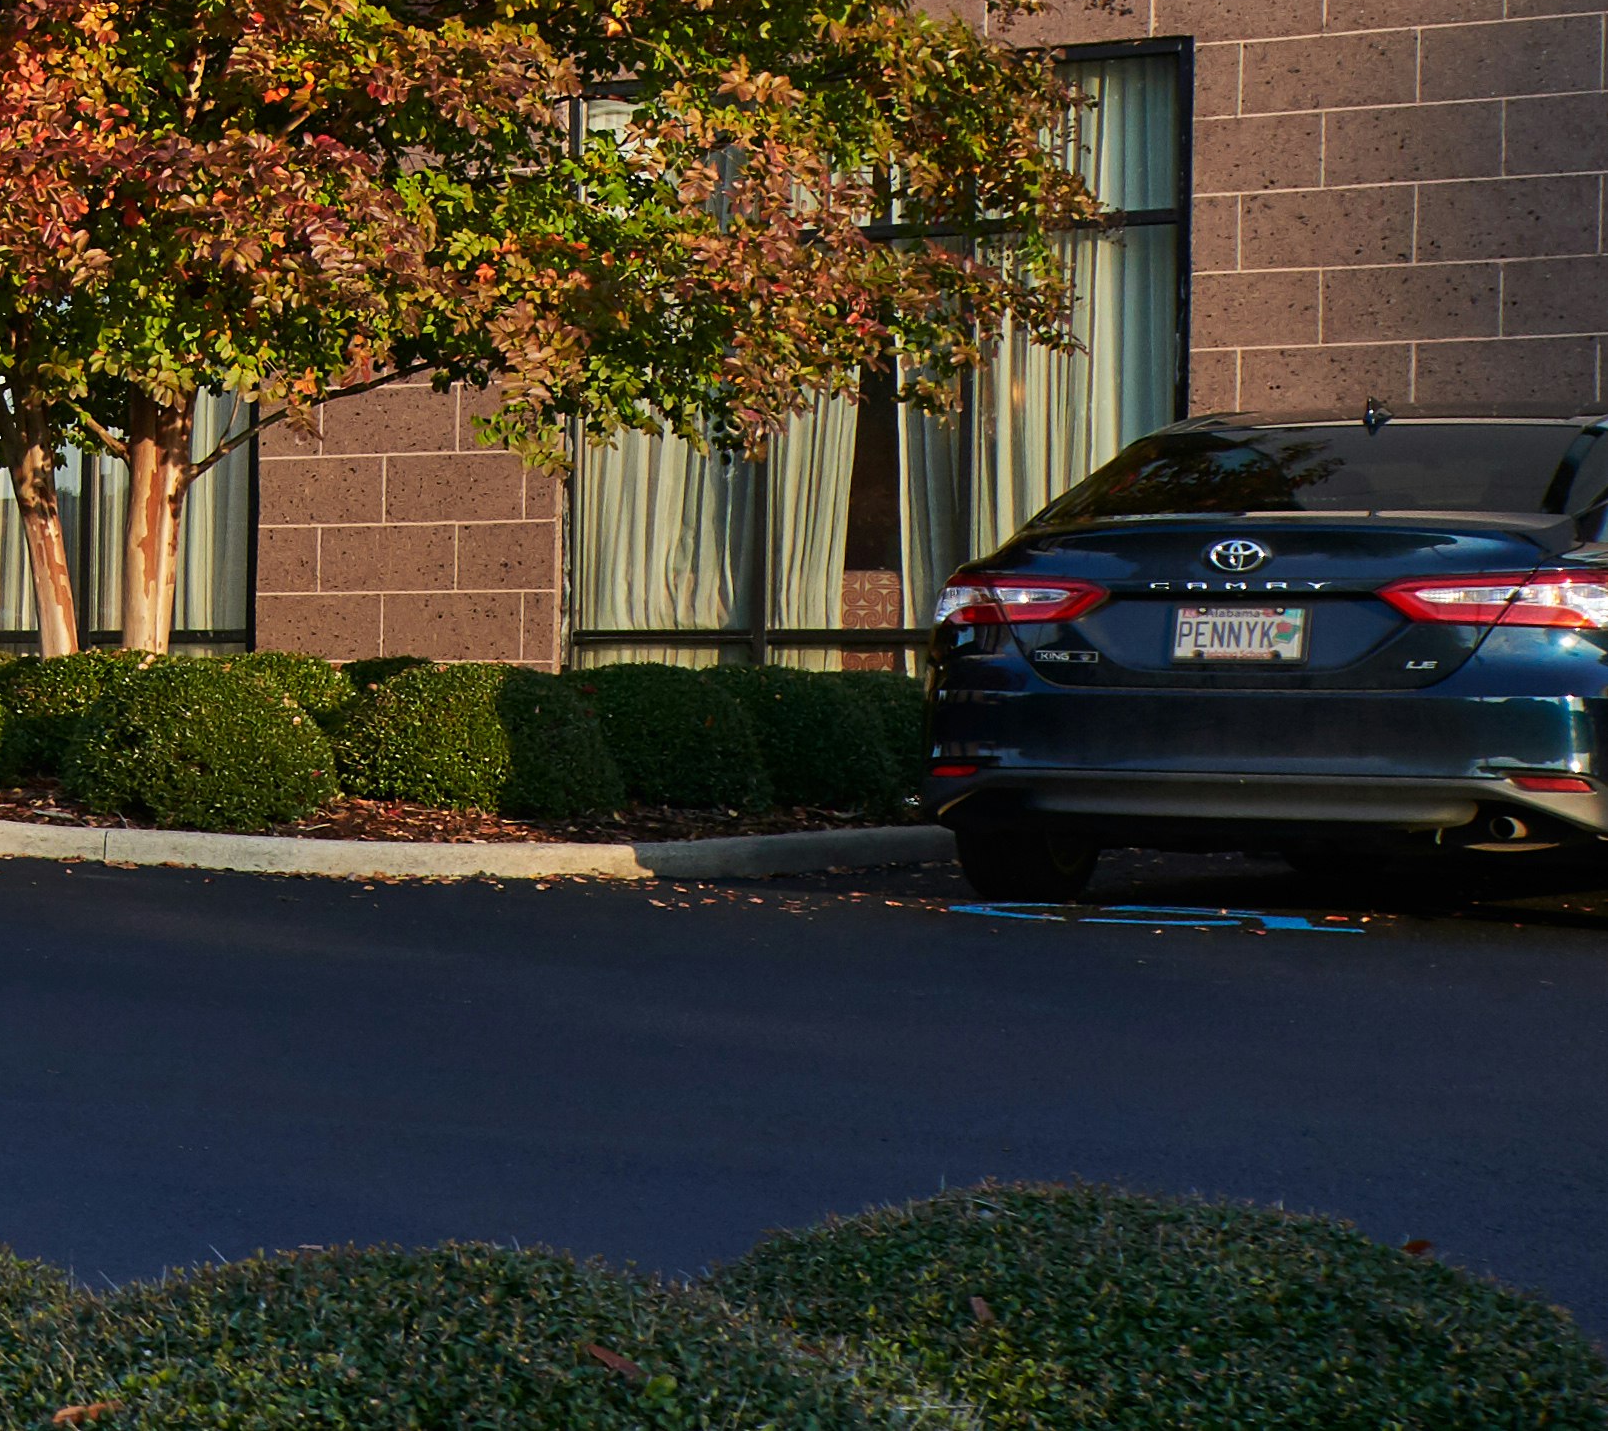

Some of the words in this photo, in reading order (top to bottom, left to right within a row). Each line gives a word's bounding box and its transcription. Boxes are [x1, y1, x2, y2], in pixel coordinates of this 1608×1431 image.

[1150, 581, 1332, 590] CAMRY
[1176, 621, 1275, 649] PENNYK
[1040, 652, 1070, 661] KING
[1405, 660, 1439, 670] LE
